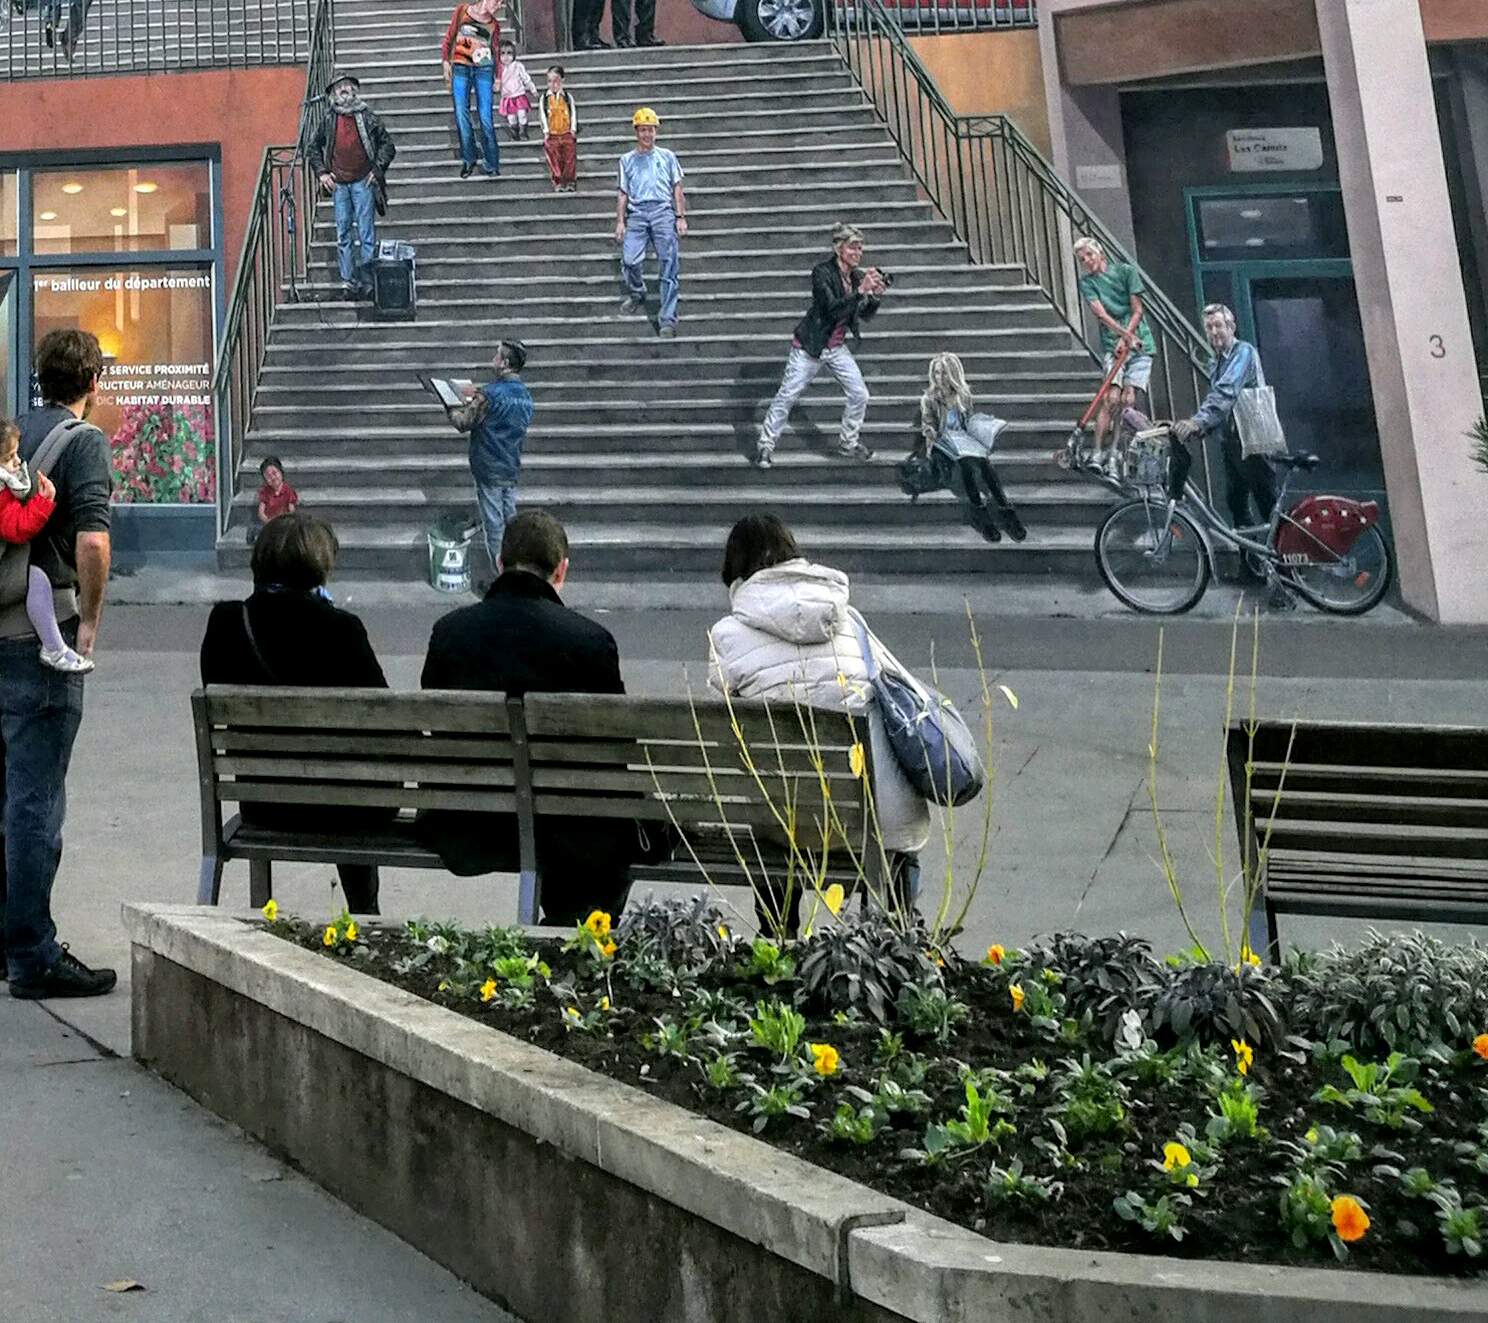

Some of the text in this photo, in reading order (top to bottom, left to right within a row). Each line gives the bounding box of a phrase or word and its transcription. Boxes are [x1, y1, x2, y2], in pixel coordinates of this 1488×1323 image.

[51, 278, 101, 291] bailleur
[104, 277, 121, 289] du
[124, 275, 211, 291] département
[1429, 334, 1446, 359] 3
[109, 365, 152, 375] SERVICE
[154, 363, 210, 375] PROXIMITÉ
[146, 377, 210, 390] AMÉNAGEUR
[116, 396, 159, 405] HABITAT
[161, 395, 211, 405] DURABLE
